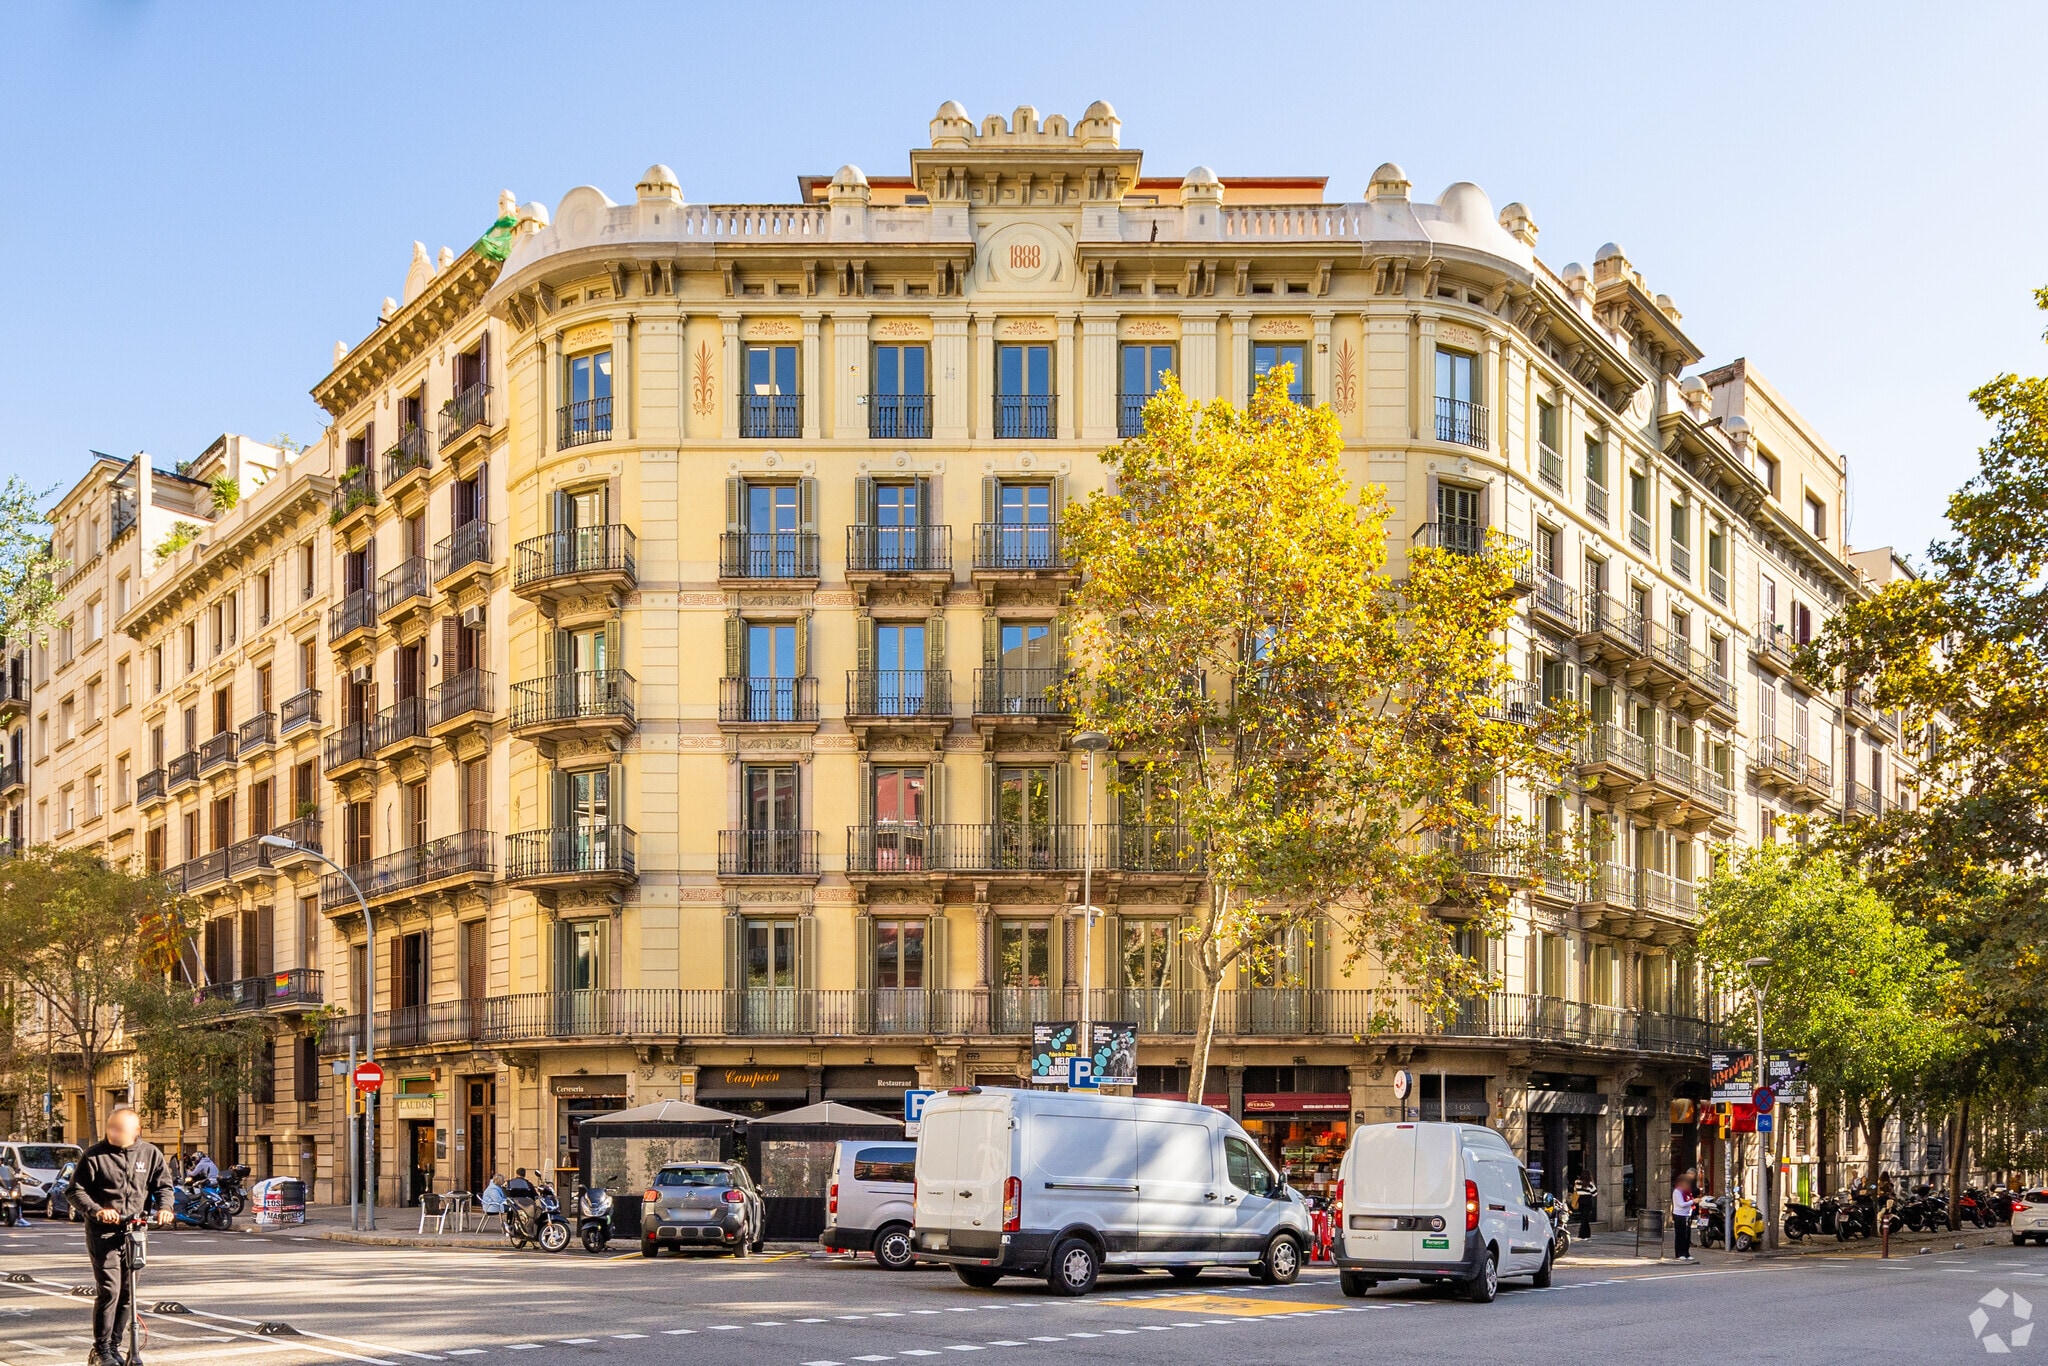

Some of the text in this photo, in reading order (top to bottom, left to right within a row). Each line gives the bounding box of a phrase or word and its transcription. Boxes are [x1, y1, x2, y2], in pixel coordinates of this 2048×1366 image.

[1009, 245, 1040, 268] 1888
[1055, 1057, 1069, 1065] MELO
[725, 1070, 780, 1088] Campeón
[1075, 1061, 1091, 1085] P
[400, 1101, 433, 1110] LAUDOS
[912, 1094, 927, 1117] P
